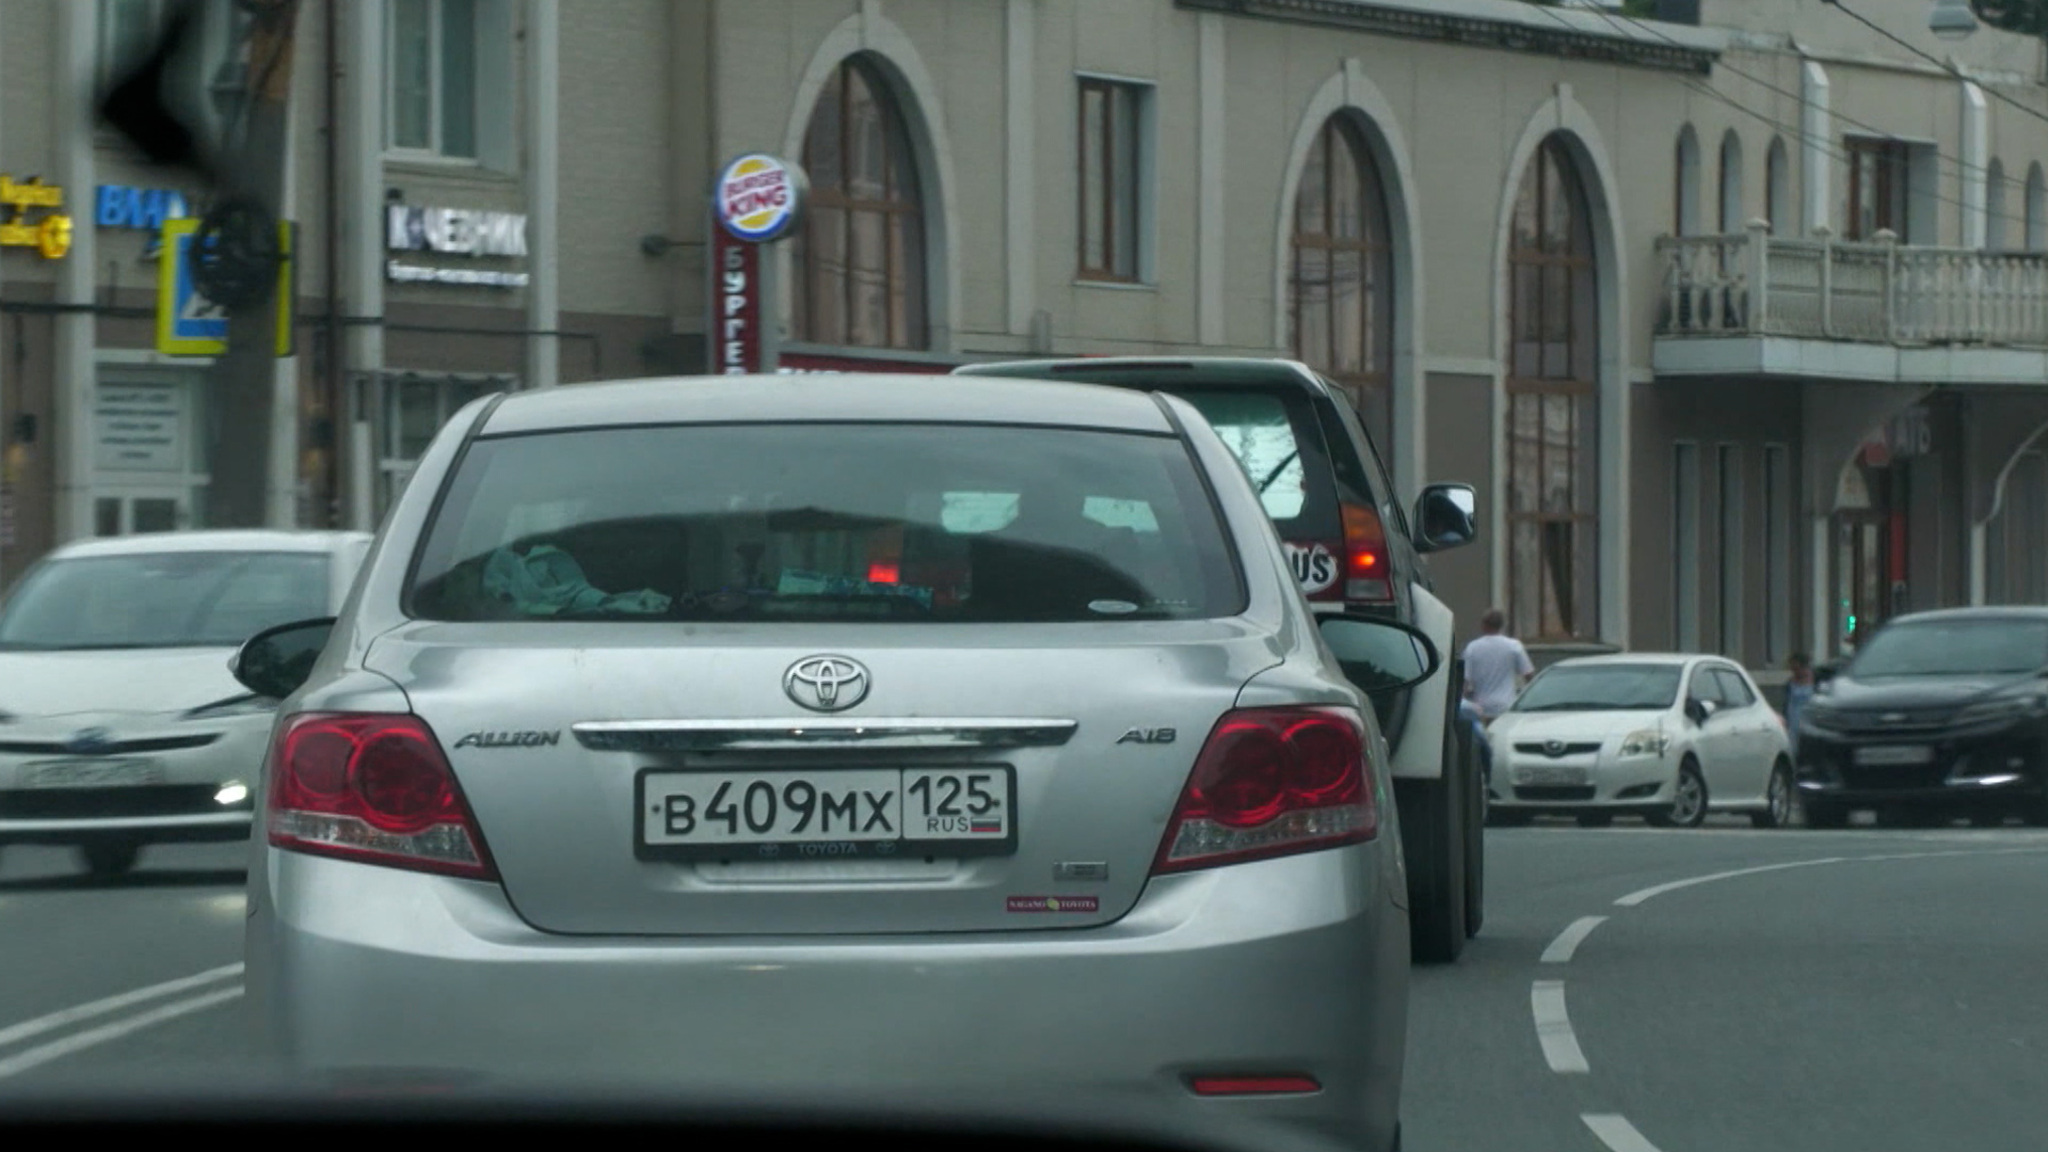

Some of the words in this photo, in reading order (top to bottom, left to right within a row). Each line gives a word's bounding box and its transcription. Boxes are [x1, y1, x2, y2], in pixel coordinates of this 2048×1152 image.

[726, 168, 784, 199] BURGER
[724, 185, 788, 220] KING
[453, 729, 562, 749] ALLION
[1115, 727, 1177, 745] A18
[907, 774, 994, 817] 125
[926, 815, 969, 833] RUS
[798, 842, 857, 855] TOYOTA
[1061, 899, 1097, 909] TOYOTA
